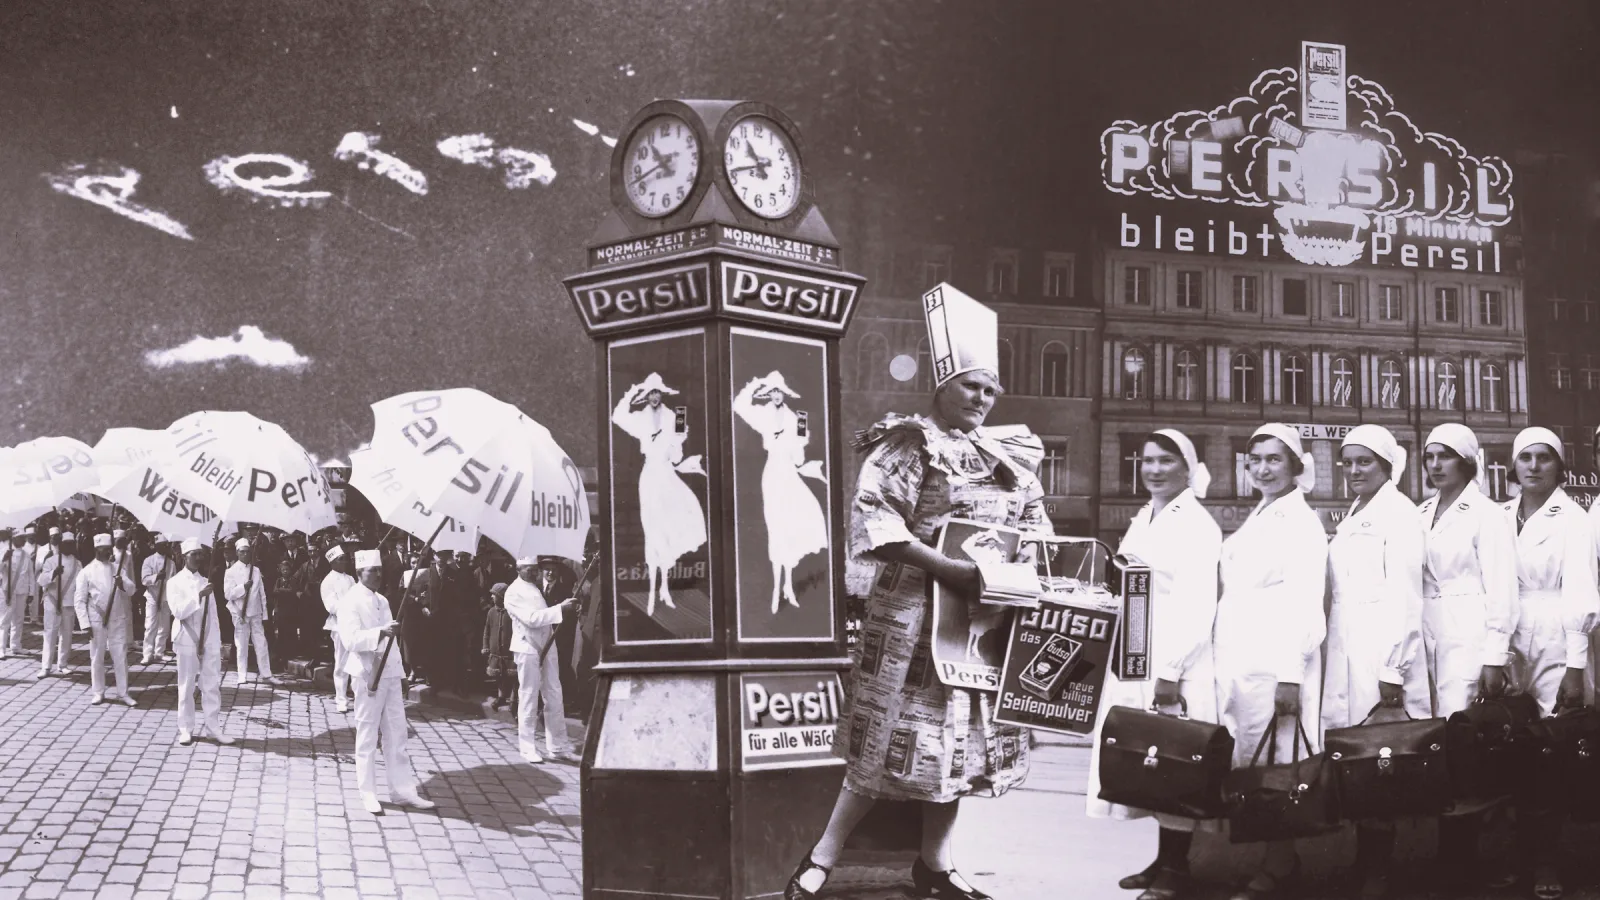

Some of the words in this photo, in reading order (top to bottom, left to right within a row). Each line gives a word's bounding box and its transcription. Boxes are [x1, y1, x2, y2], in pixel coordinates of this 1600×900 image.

[1309, 47, 1340, 70] Persil
[660, 123, 670, 138] 12
[740, 125, 748, 139] 11
[753, 123, 763, 138] 12
[729, 136, 740, 149] 10
[637, 146, 648, 160] 10
[725, 152, 733, 165] 9
[778, 148, 785, 161] 2
[634, 165, 642, 180] 9
[783, 166, 791, 180] 3
[1111, 133, 1508, 216] PERSIL
[638, 181, 647, 196] 8
[676, 186, 685, 200] 5
[741, 186, 748, 200] 7
[778, 183, 786, 196] 4
[649, 191, 656, 206] 7
[662, 193, 671, 208] 6
[754, 193, 763, 208] 6
[769, 192, 777, 206] 5
[1120, 212, 1274, 256] bleibt
[1405, 217, 1493, 242] Minuten
[1371, 231, 1501, 272] Persil
[587, 271, 698, 318] Persil
[733, 270, 841, 315] Persil
[400, 395, 525, 514] Persil
[1138, 574, 1148, 592] Persil
[1020, 631, 1041, 644] das
[1126, 656, 1136, 675] Henkel
[1136, 656, 1146, 675] Persil
[1069, 682, 1095, 693] neue
[745, 681, 839, 723] Persil
[1062, 689, 1093, 706] billige
[1002, 692, 1093, 723] Seifenpulver
[748, 733, 767, 750] für
[772, 732, 798, 749] alle
